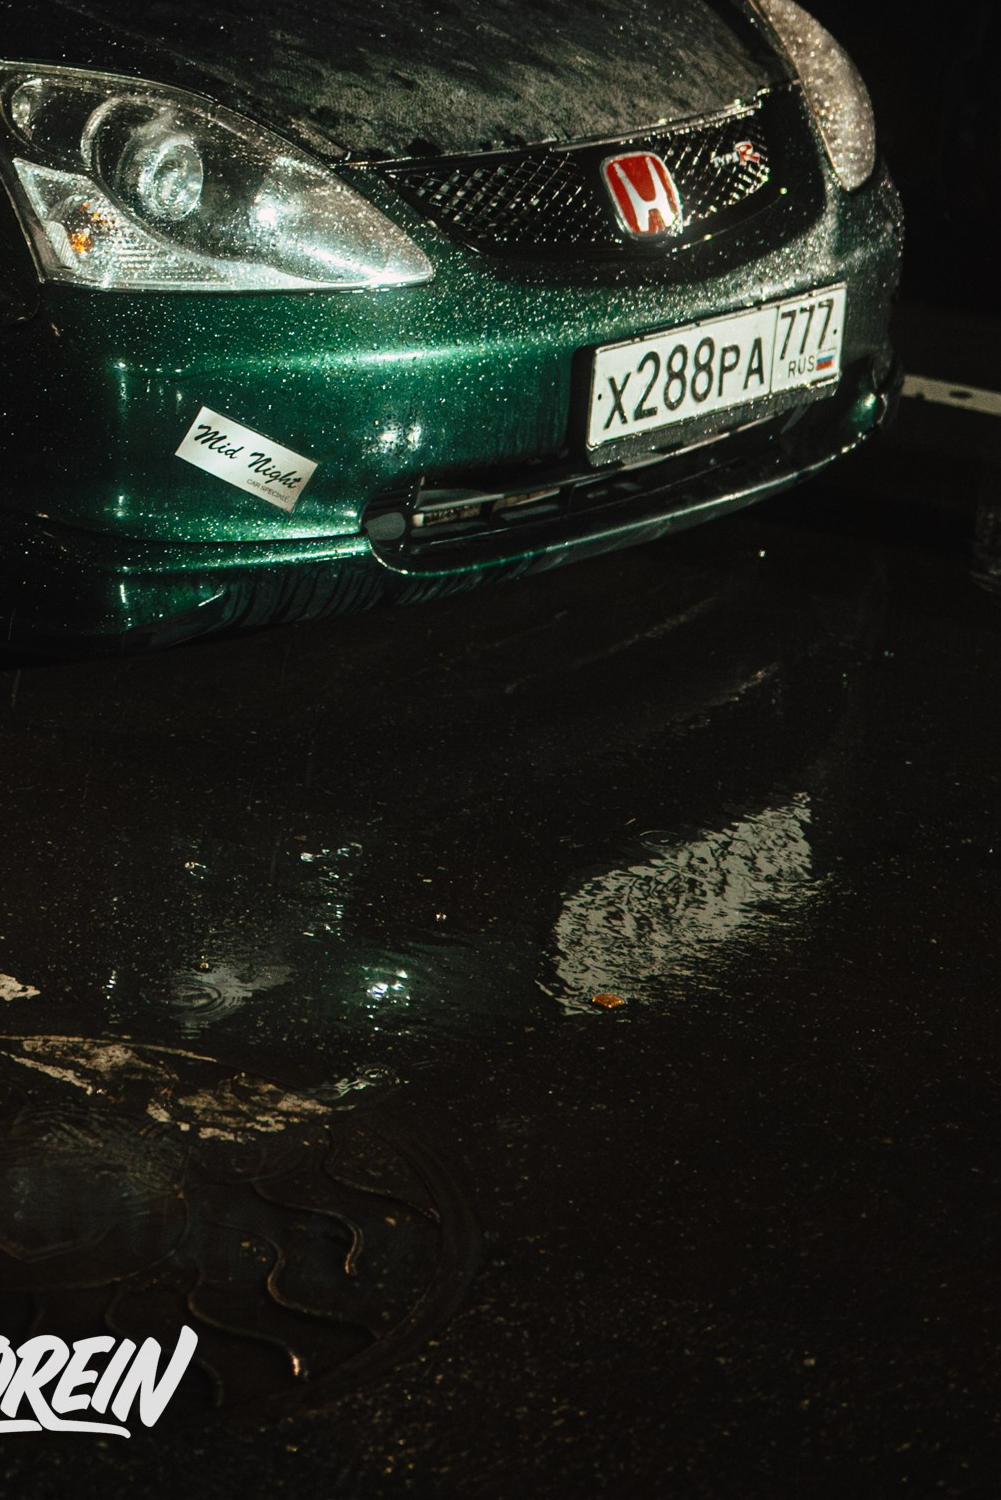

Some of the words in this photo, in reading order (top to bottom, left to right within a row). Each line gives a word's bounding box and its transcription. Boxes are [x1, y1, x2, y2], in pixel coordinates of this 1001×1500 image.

[779, 298, 835, 361] 777
[788, 354, 816, 379] RUS
[194, 424, 244, 460] Mid
[248, 452, 303, 489] Night
[246, 478, 261, 490] CAR
